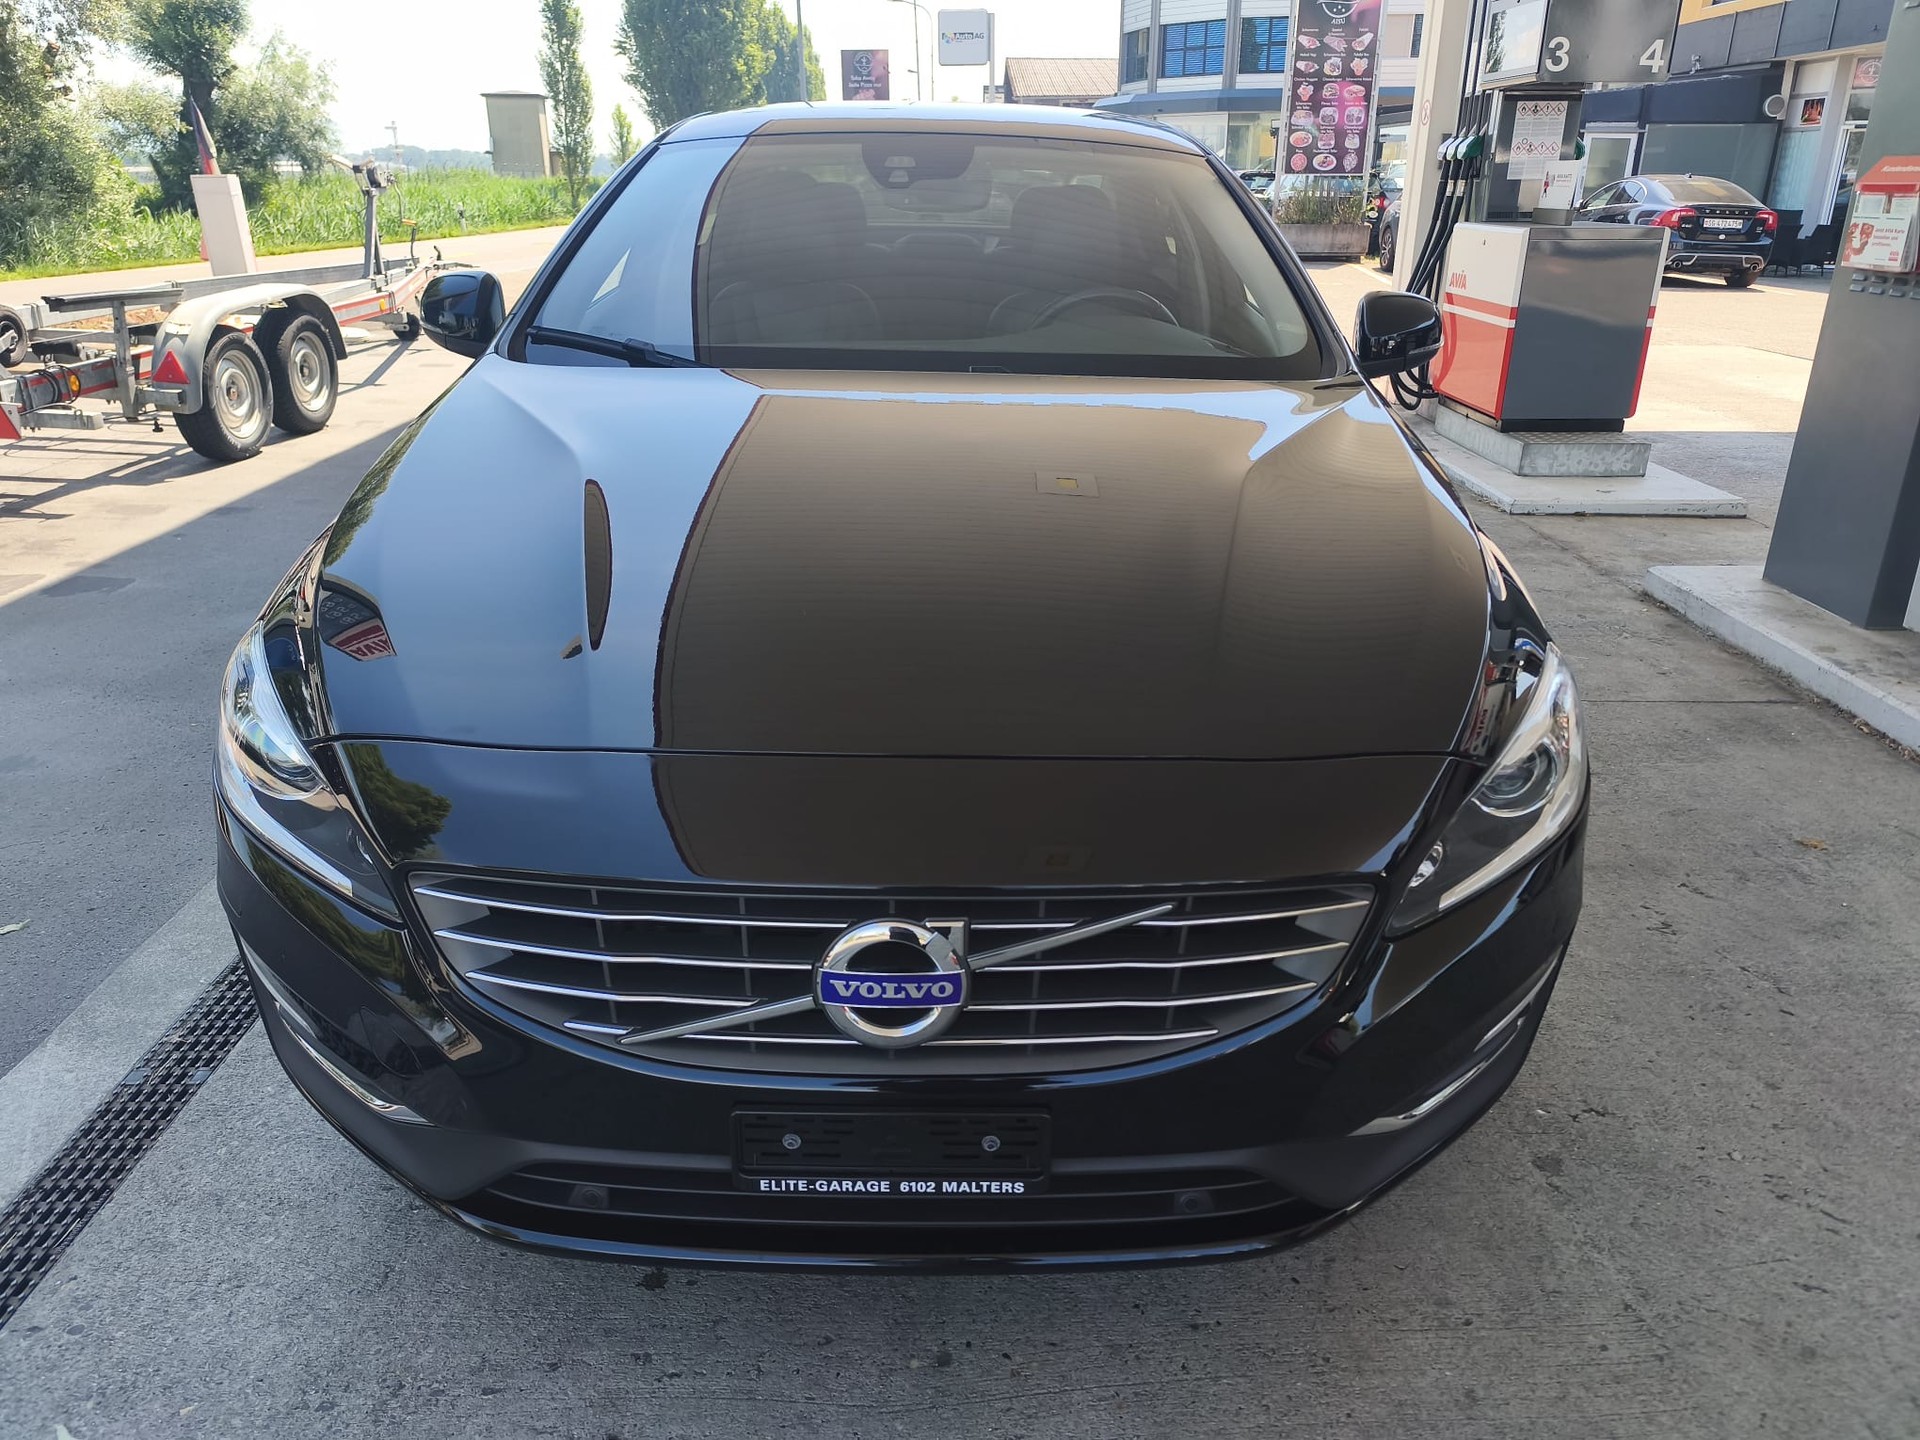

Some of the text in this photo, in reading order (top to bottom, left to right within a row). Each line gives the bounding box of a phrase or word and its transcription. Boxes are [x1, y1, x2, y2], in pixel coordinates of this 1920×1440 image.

[1545, 36, 1571, 73] 3
[1639, 39, 1665, 73] 4
[1449, 270, 1467, 290] AVIA
[829, 979, 954, 999] VOLVO
[760, 1179, 1025, 1193] ELITE-GARAGE 6102 MALTERS
